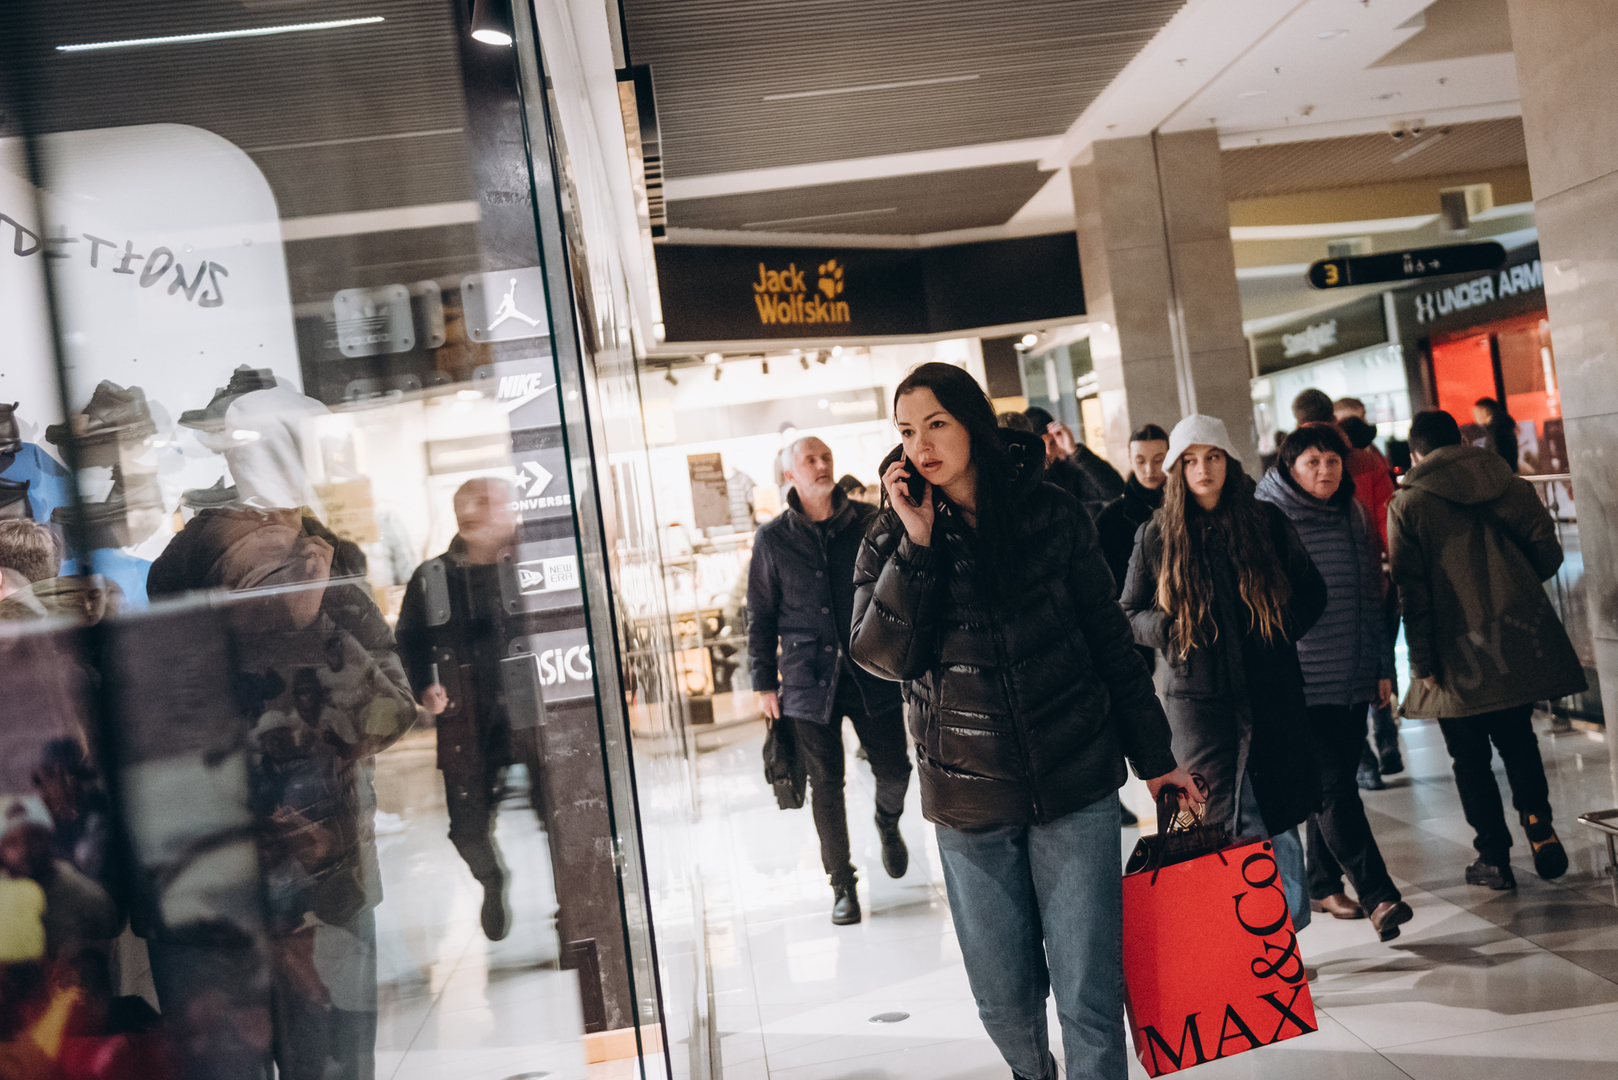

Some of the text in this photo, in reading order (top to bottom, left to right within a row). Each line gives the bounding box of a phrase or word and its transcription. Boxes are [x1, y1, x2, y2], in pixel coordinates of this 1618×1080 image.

[753, 262, 807, 293] Jack
[1323, 263, 1339, 286] 3
[755, 293, 851, 324] Wolfskin
[1435, 275, 1495, 316] UNDER
[497, 372, 543, 399] NIKE
[549, 563, 572, 574] NEW
[550, 572, 574, 583] ERA
